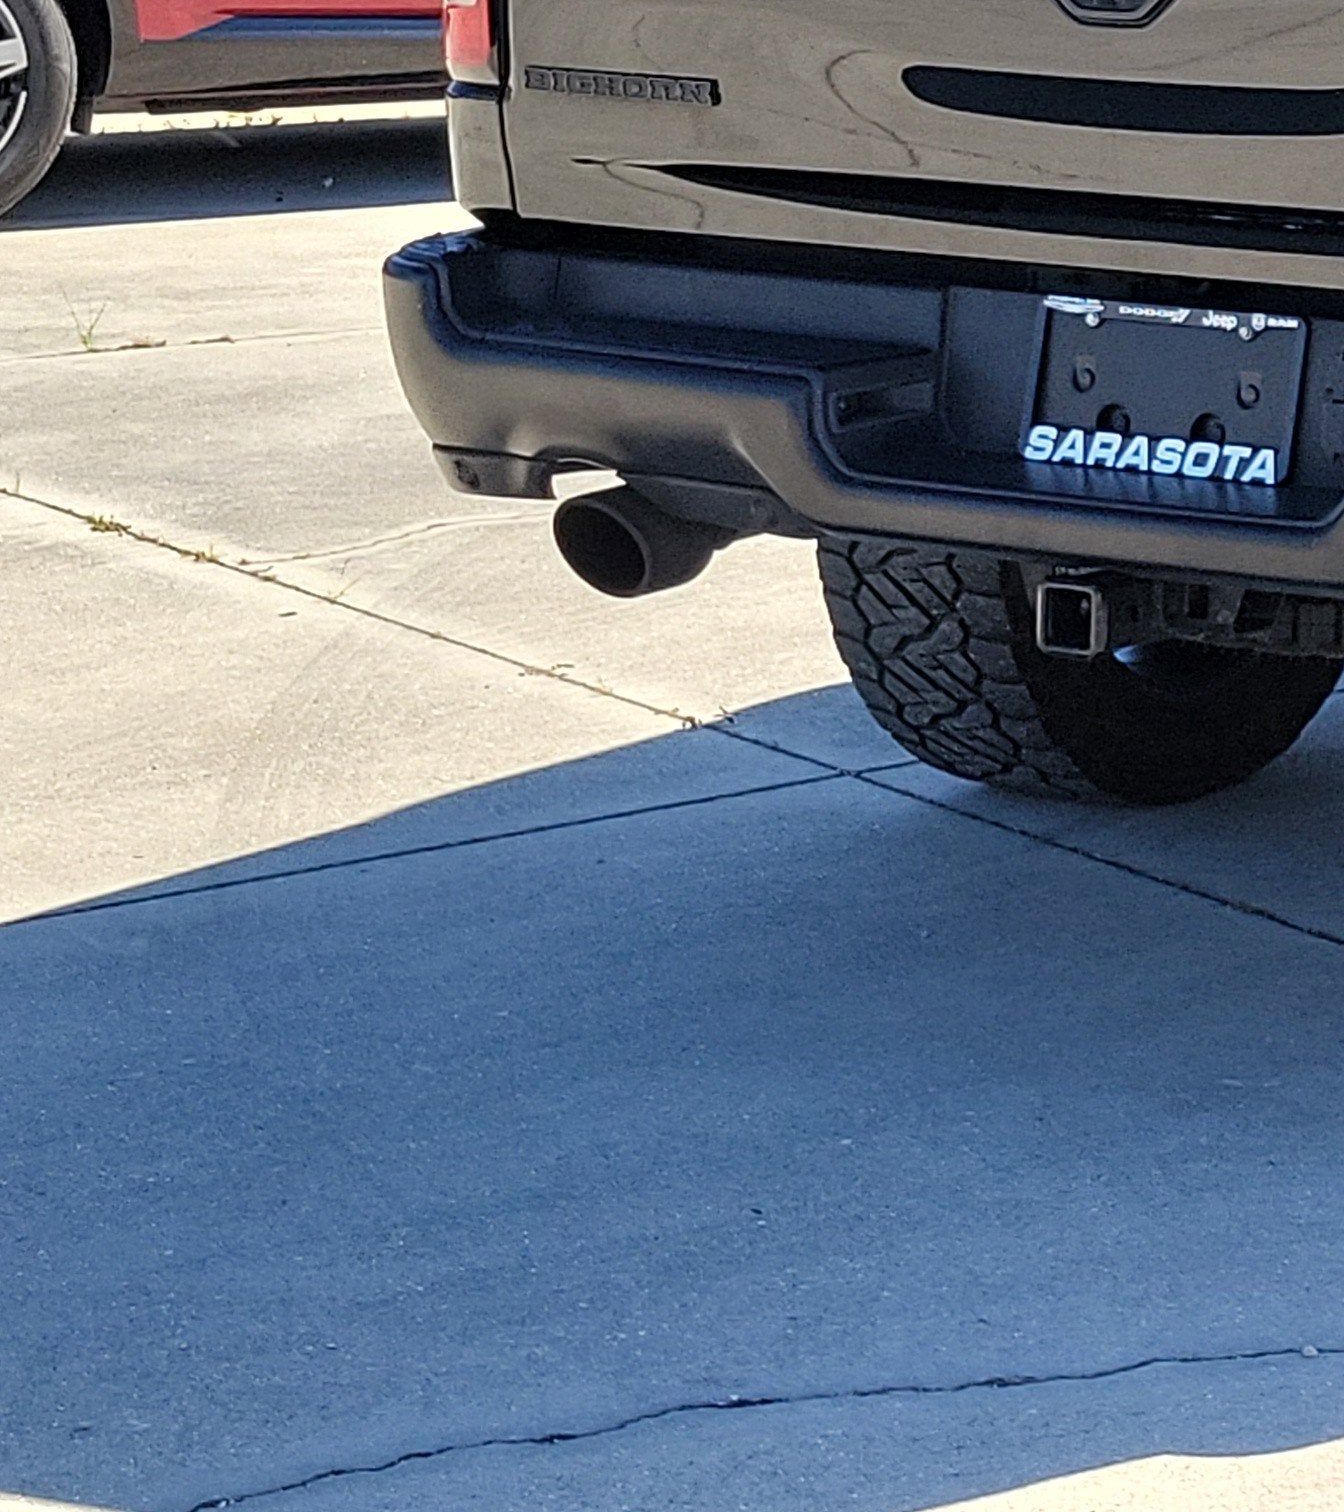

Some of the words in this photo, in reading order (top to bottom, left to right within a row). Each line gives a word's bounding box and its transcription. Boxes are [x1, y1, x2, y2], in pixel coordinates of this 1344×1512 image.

[525, 65, 721, 106] BIGHORN
[1202, 310, 1238, 331] Jeep
[1024, 424, 1278, 485] SARASOTA
